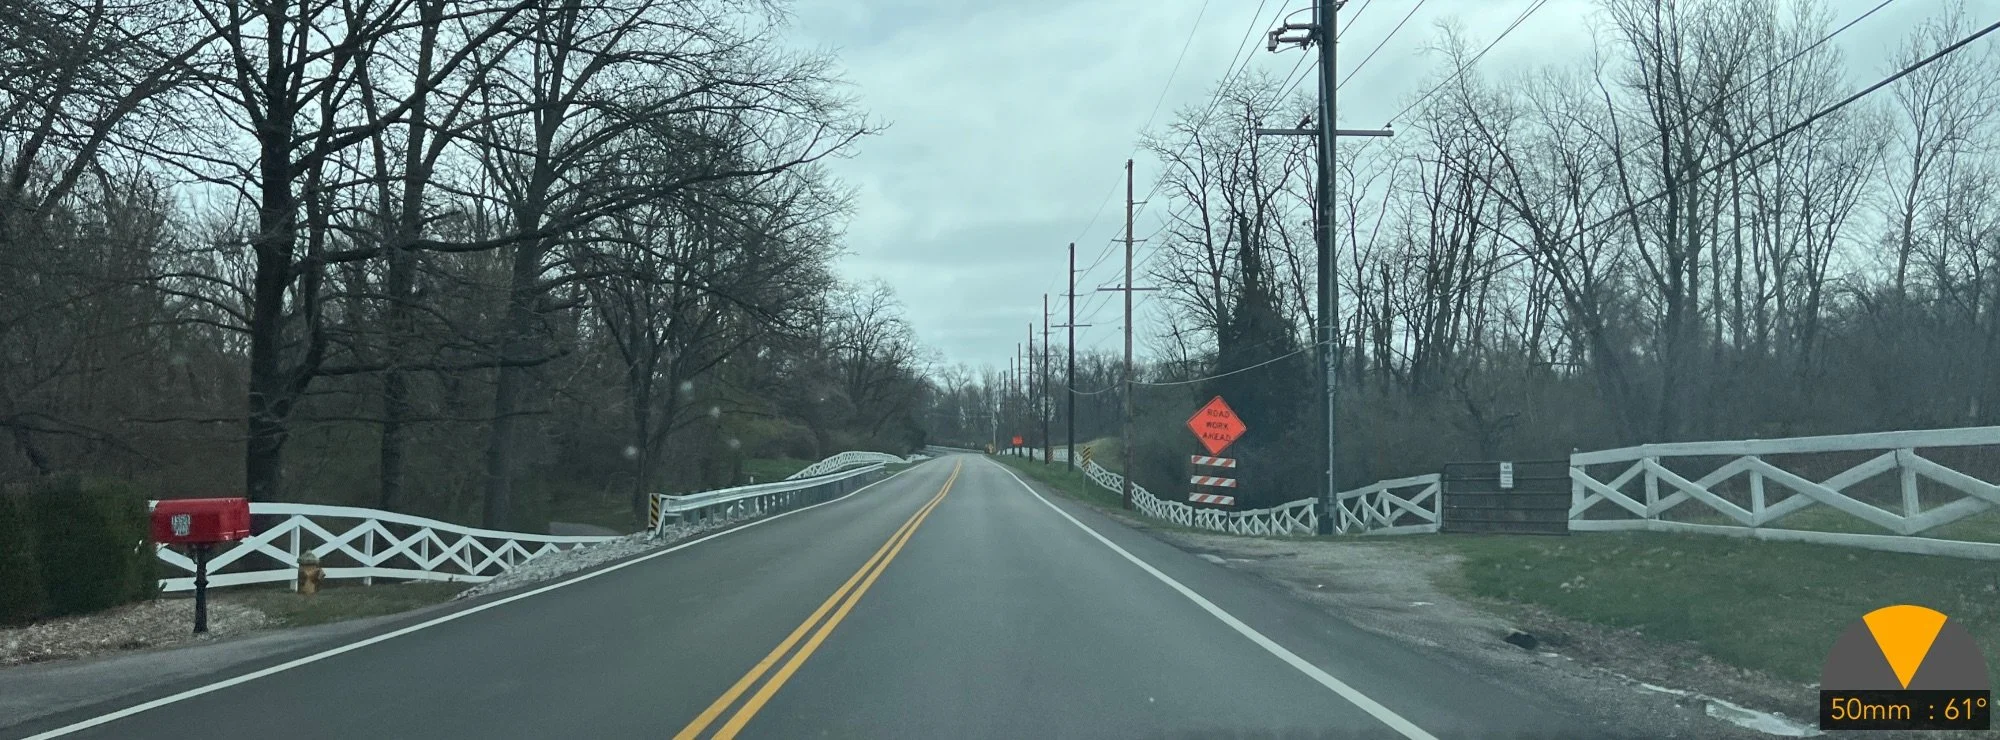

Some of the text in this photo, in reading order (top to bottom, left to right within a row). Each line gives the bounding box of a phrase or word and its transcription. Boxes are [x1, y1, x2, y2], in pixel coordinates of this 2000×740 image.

[1207, 409, 1230, 418] ROAD
[1206, 422, 1229, 430] WORK
[1203, 432, 1231, 441] AHEAD
